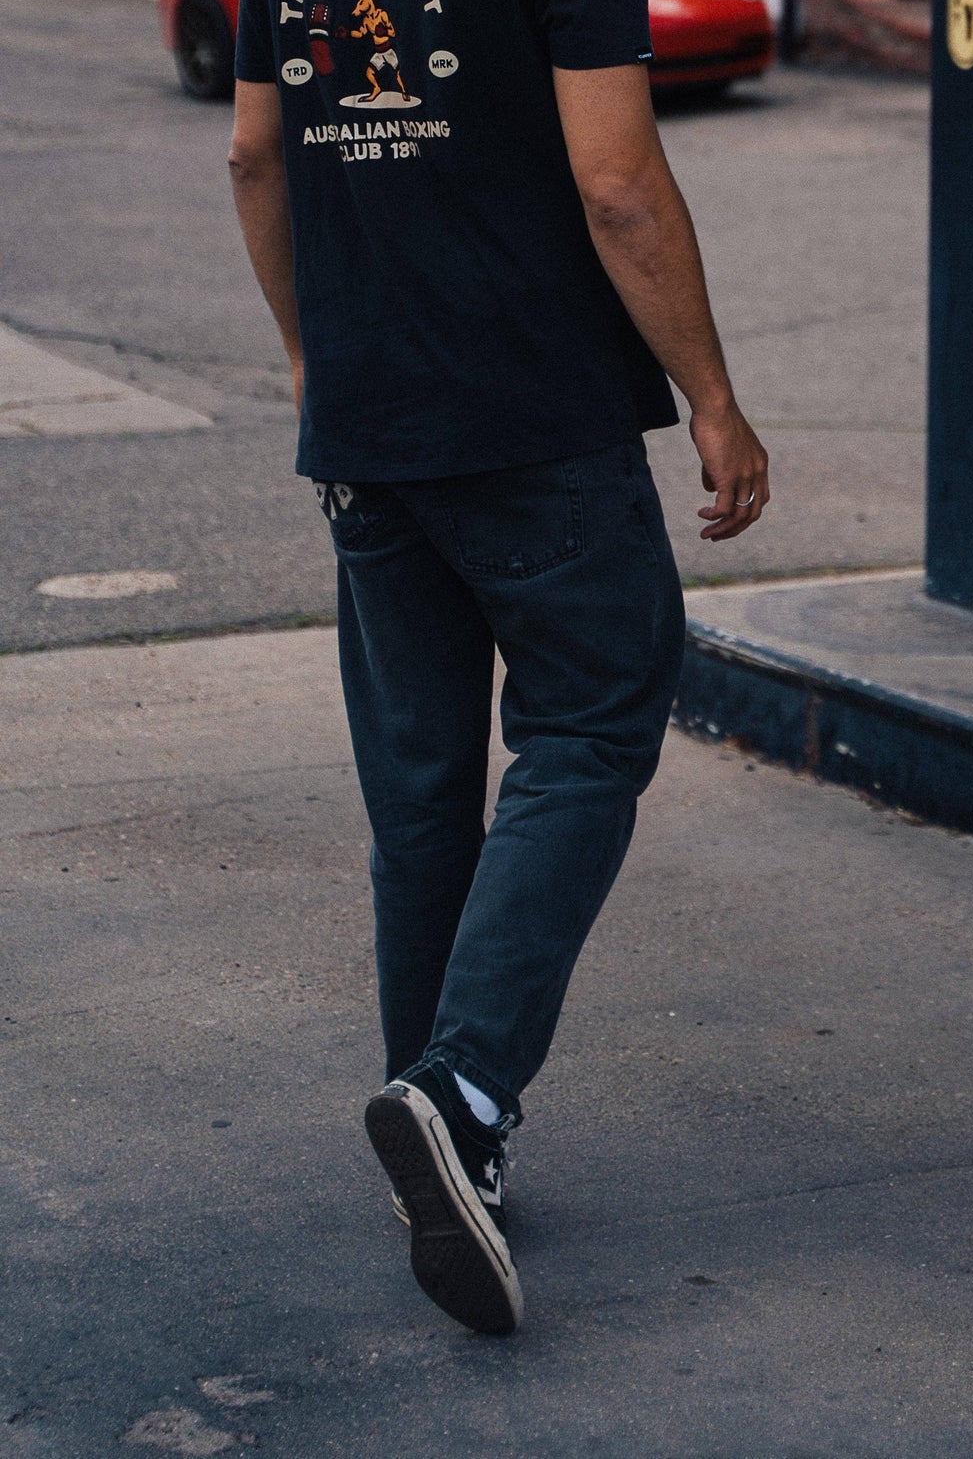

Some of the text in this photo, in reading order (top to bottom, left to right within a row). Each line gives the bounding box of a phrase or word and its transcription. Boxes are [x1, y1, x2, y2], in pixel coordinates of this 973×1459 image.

[431, 58, 454, 70] MRK
[286, 66, 308, 78] TRD
[402, 120, 450, 138] BOXING
